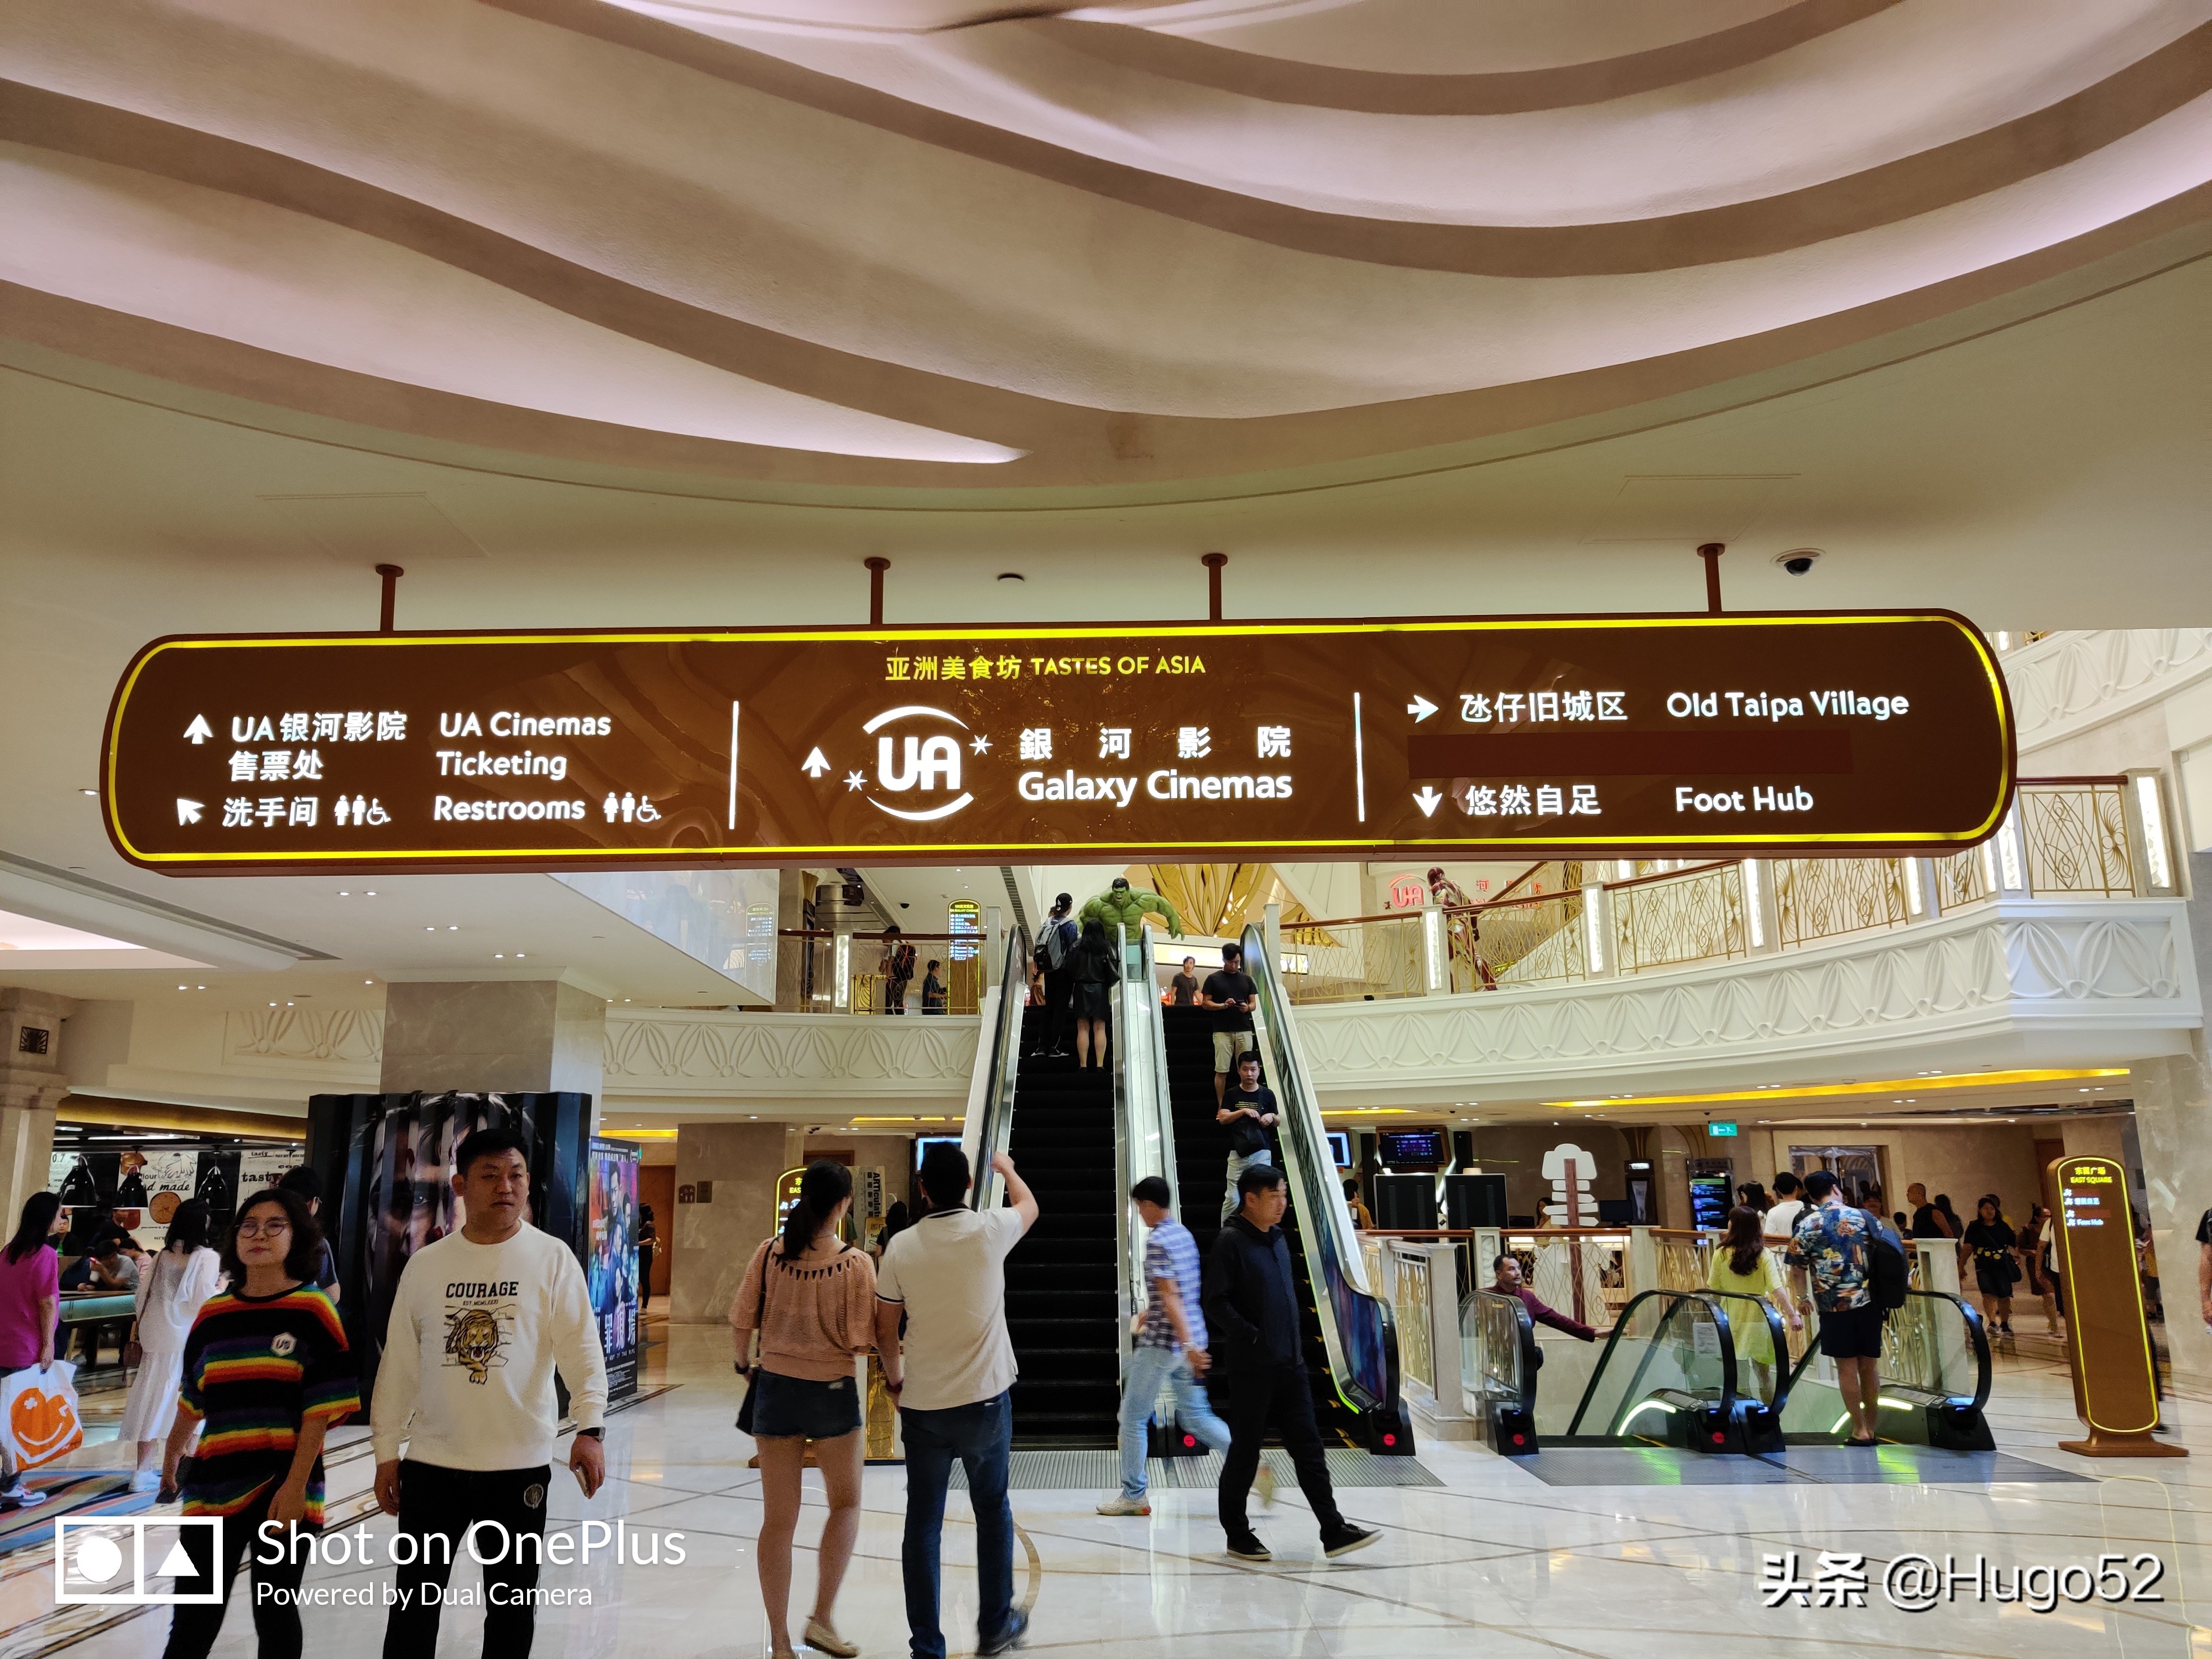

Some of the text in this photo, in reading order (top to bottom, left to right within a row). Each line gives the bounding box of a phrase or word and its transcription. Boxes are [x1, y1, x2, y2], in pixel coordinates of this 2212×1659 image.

[885, 655, 1022, 681] 亚洲美食坊
[1030, 655, 1207, 676] TASTES OF ASIA
[1459, 690, 1628, 723] 氹仔旧城区
[1666, 690, 1910, 723] Old Taipa Village
[440, 711, 612, 738] UA Cinemas
[227, 749, 324, 781] 售票处
[435, 749, 567, 781] Ticketing
[878, 735, 961, 791] UA
[1018, 768, 1293, 808] Galaxy Cinemas
[1464, 784, 1603, 816] 悠然自足
[1675, 785, 1814, 812] Foot Hub
[221, 796, 319, 828] 洗手间
[434, 795, 586, 822] Restrooms
[1392, 884, 1425, 908] UA
[445, 1281, 519, 1298] COURAGE
